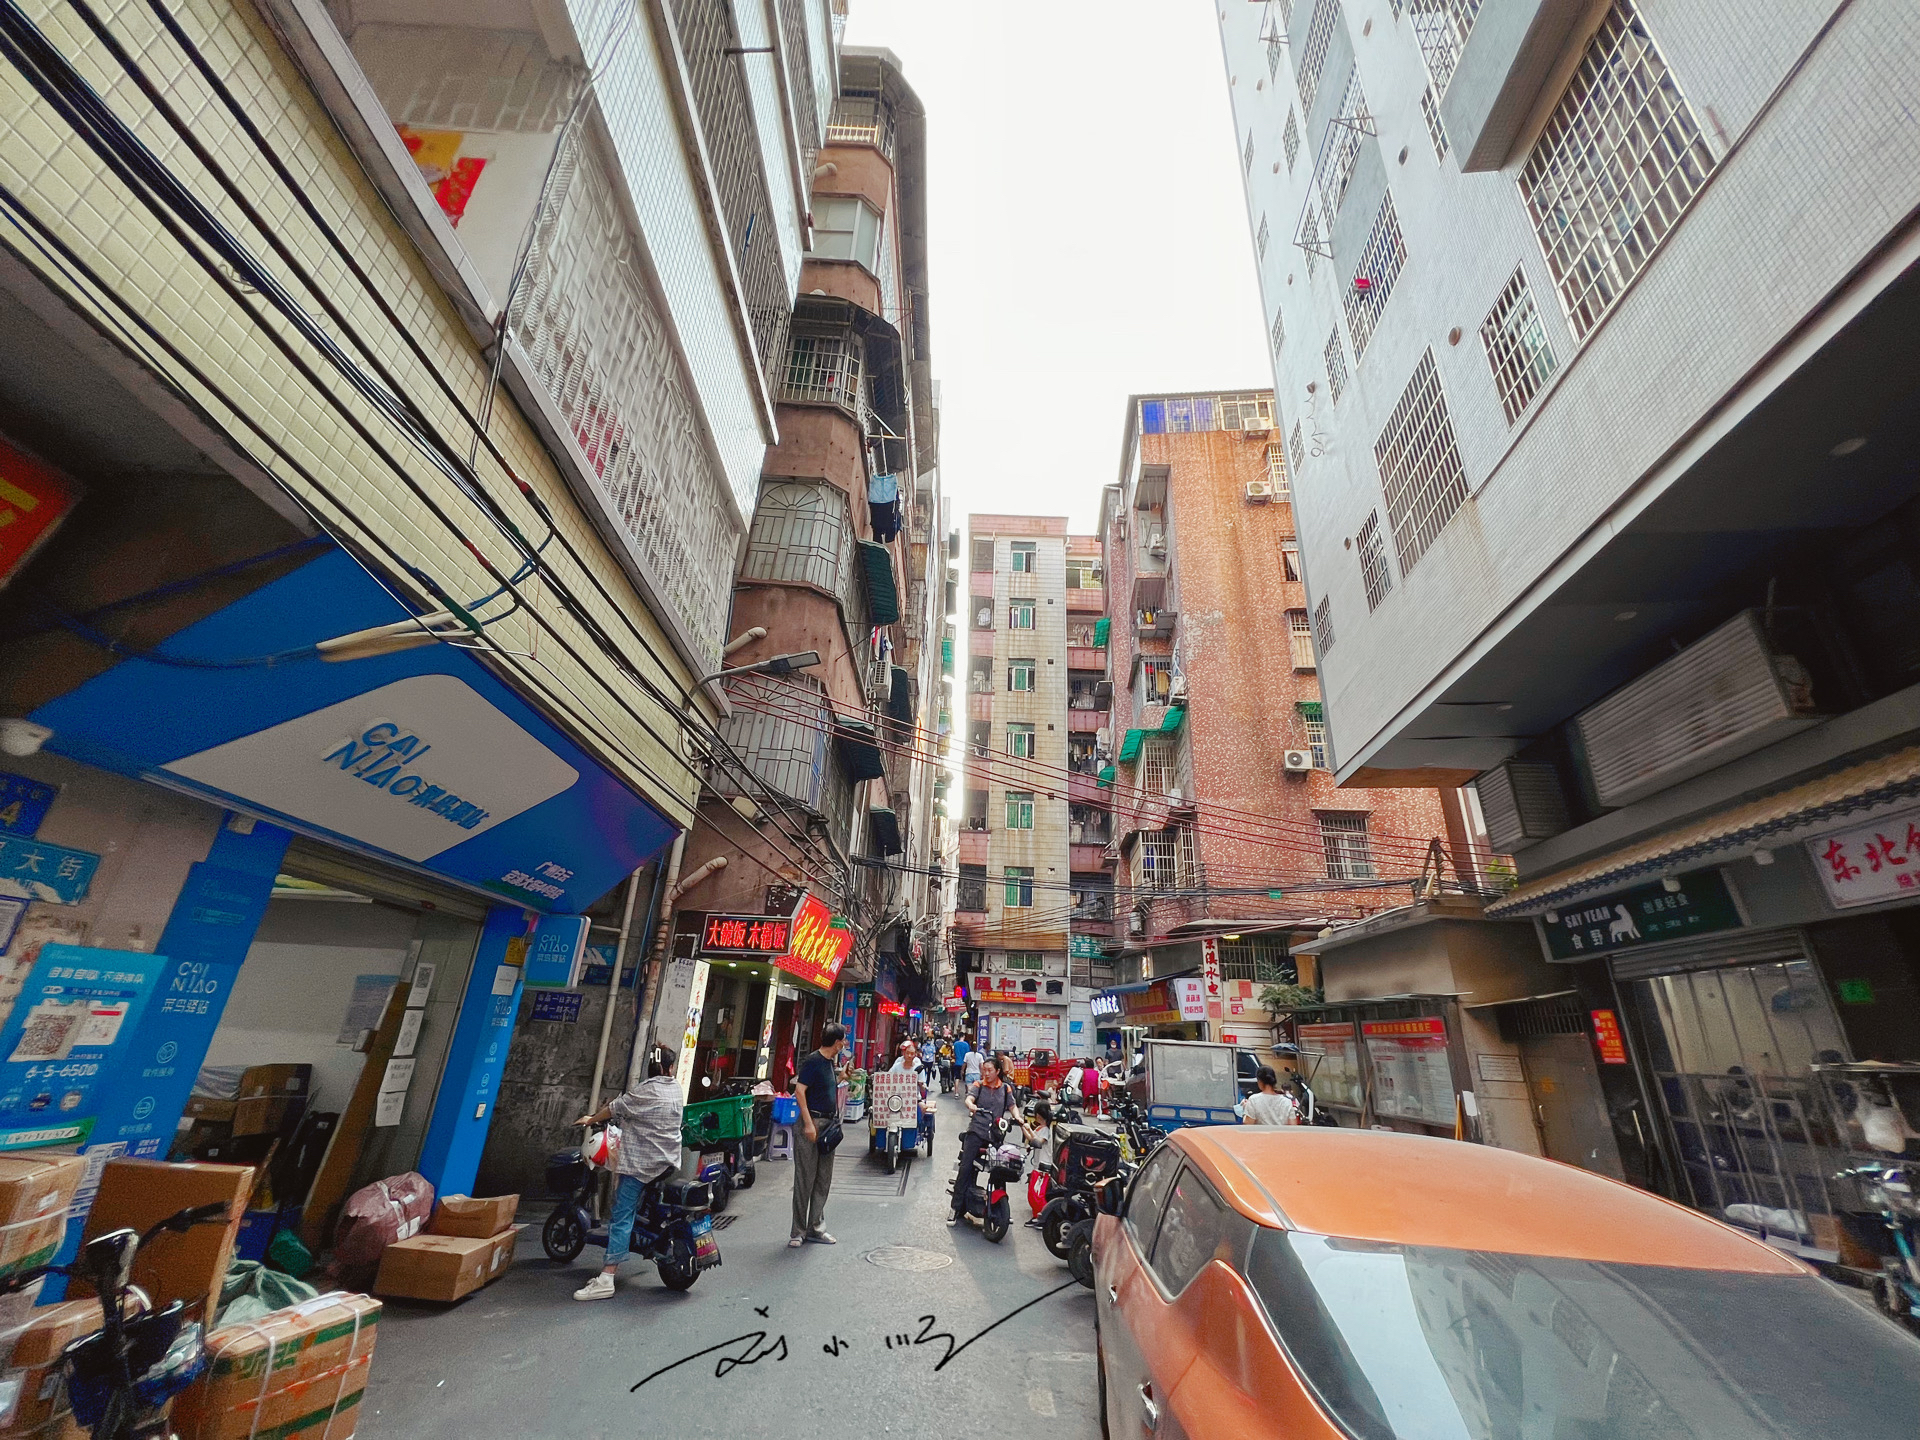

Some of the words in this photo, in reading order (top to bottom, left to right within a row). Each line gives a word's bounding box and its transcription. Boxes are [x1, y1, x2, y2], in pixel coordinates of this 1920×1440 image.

[361, 722, 431, 764] CAI
[0, 842, 84, 881] 大街
[1564, 913, 1583, 929] SAY
[1584, 906, 1611, 924] YEAH
[541, 934, 561, 943] CAI
[706, 919, 745, 948] 大碗饭
[178, 961, 210, 977] CAI
[161, 998, 211, 1015] 菜鸟驿站
[858, 992, 873, 1007] 药
